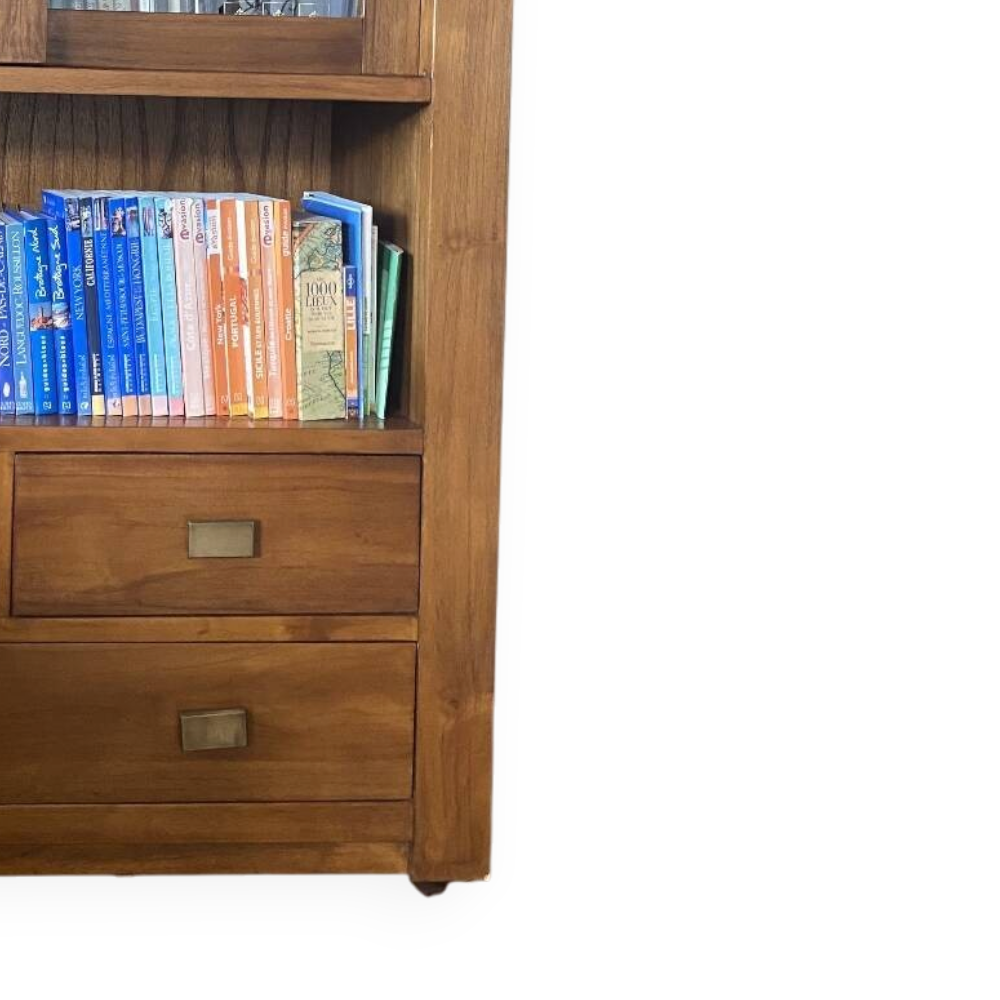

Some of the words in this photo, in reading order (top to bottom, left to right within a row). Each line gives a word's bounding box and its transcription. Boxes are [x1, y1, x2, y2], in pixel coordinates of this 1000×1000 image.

[28, 227, 40, 252] Nord
[49, 224, 61, 251] Sud
[281, 230, 291, 257] guide
[83, 238, 96, 287] CALIFORNIE
[71, 265, 82, 295] YORK
[306, 281, 337, 296] 1000
[74, 295, 84, 320] NEW
[306, 296, 337, 307] LIEUX
[346, 299, 355, 330] LILLE
[215, 325, 224, 345] New
[229, 295, 240, 348] PORTUGAL
[284, 307, 293, 341] Croatie
[252, 350, 264, 380] SICILE
